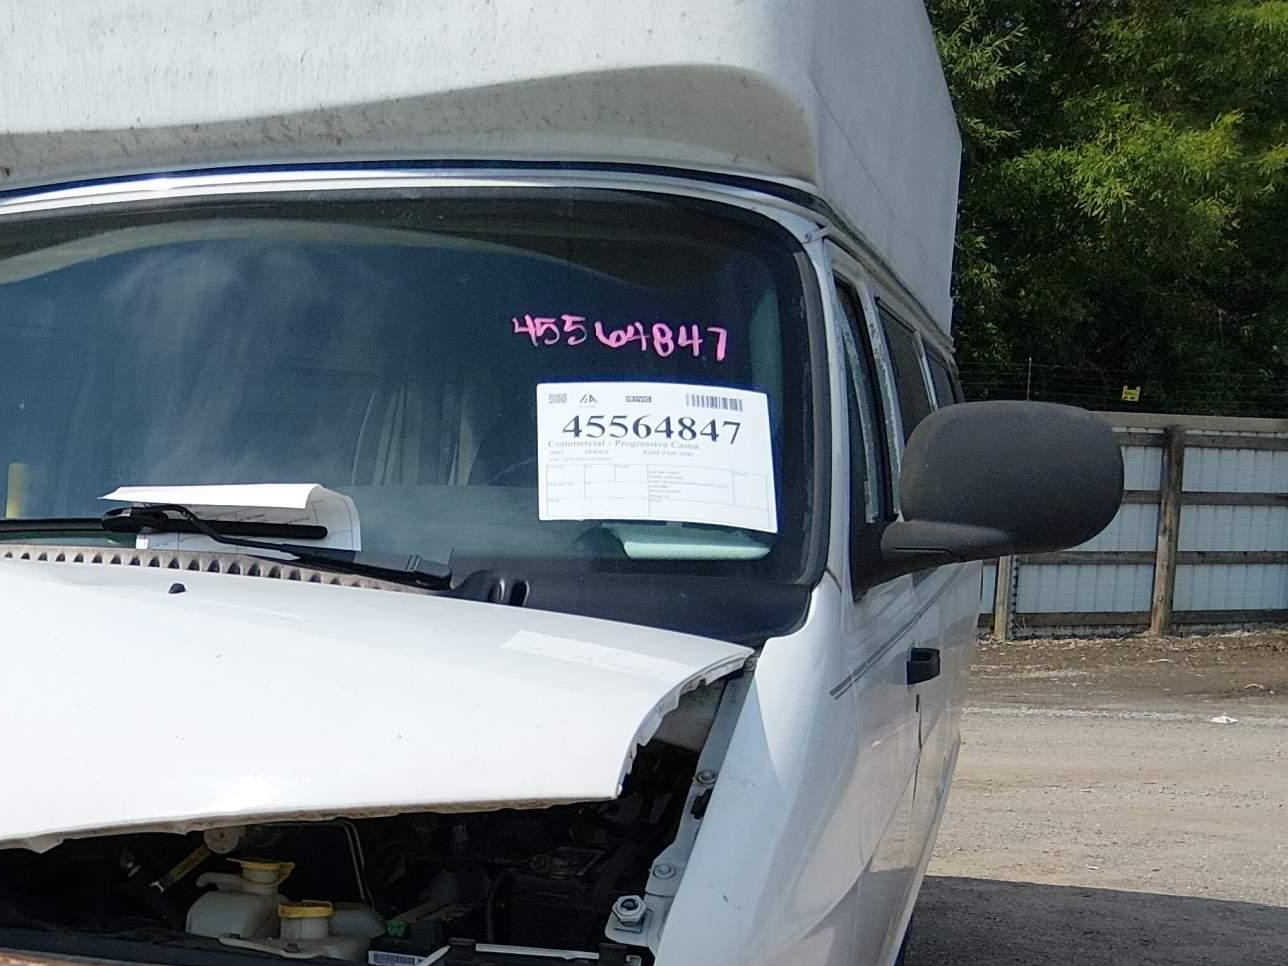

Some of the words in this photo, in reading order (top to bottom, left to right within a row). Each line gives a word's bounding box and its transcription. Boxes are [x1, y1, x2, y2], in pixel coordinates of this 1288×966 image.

[512, 314, 727, 362] 45564847
[547, 440, 605, 448] Commercial
[615, 440, 669, 450] Progressive
[562, 414, 742, 445] 45564847
